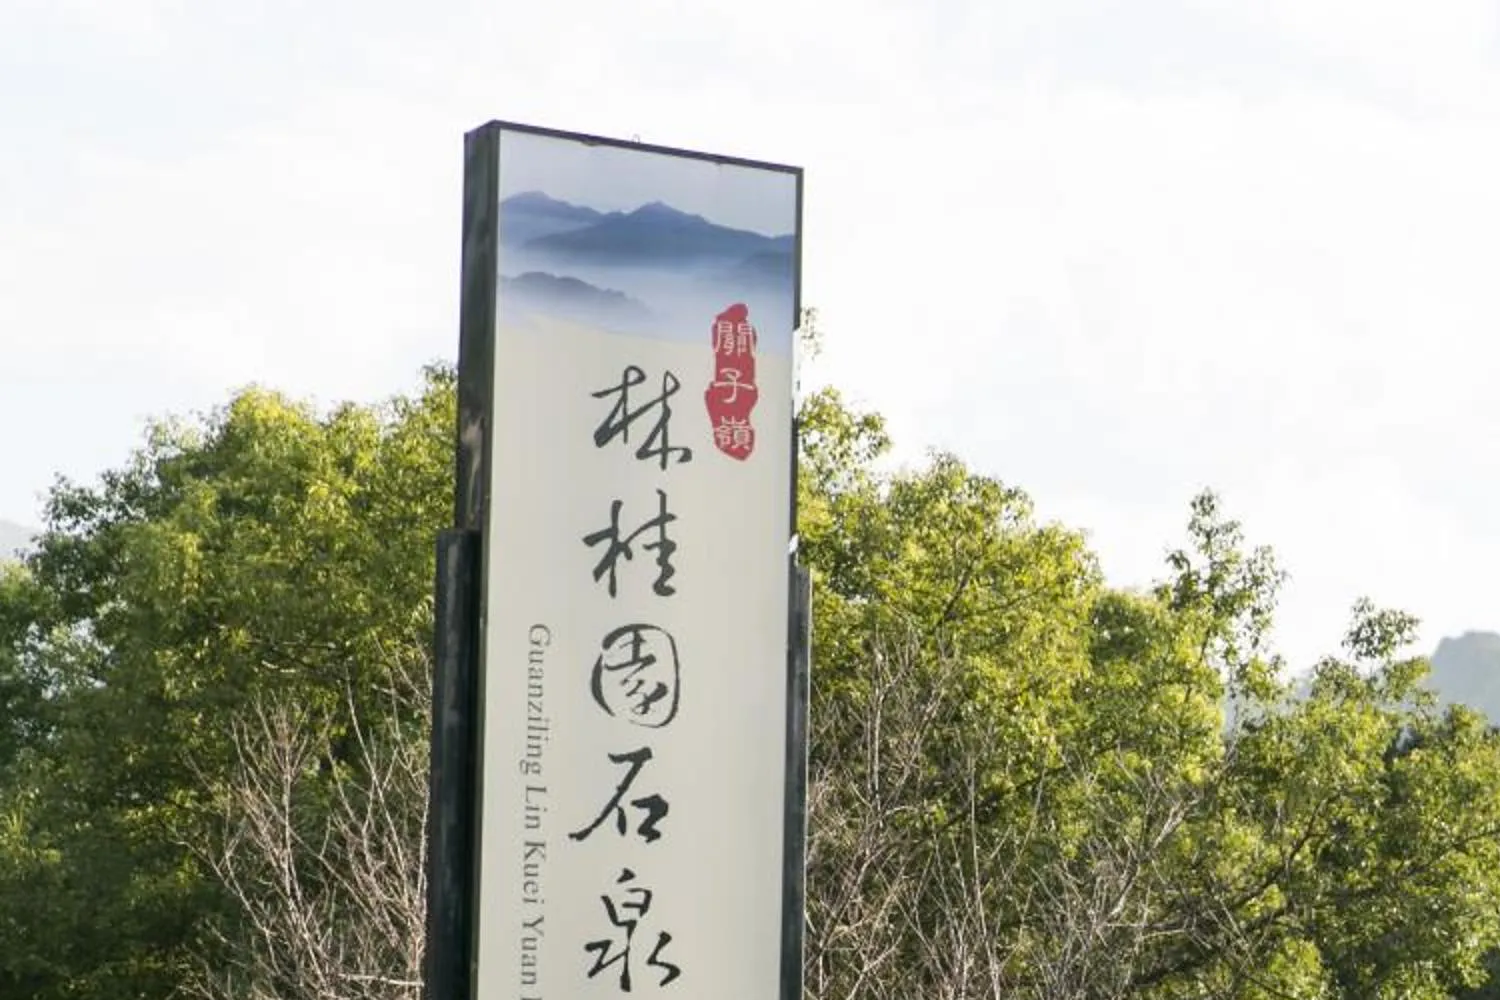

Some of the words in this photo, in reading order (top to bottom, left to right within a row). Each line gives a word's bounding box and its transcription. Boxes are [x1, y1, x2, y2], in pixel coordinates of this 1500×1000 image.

[713, 321, 756, 450] 關子嶺
[519, 623, 551, 776] Guanziling
[524, 785, 548, 830] Lin
[522, 840, 547, 905] Kuei
[520, 914, 545, 986] Yuan
